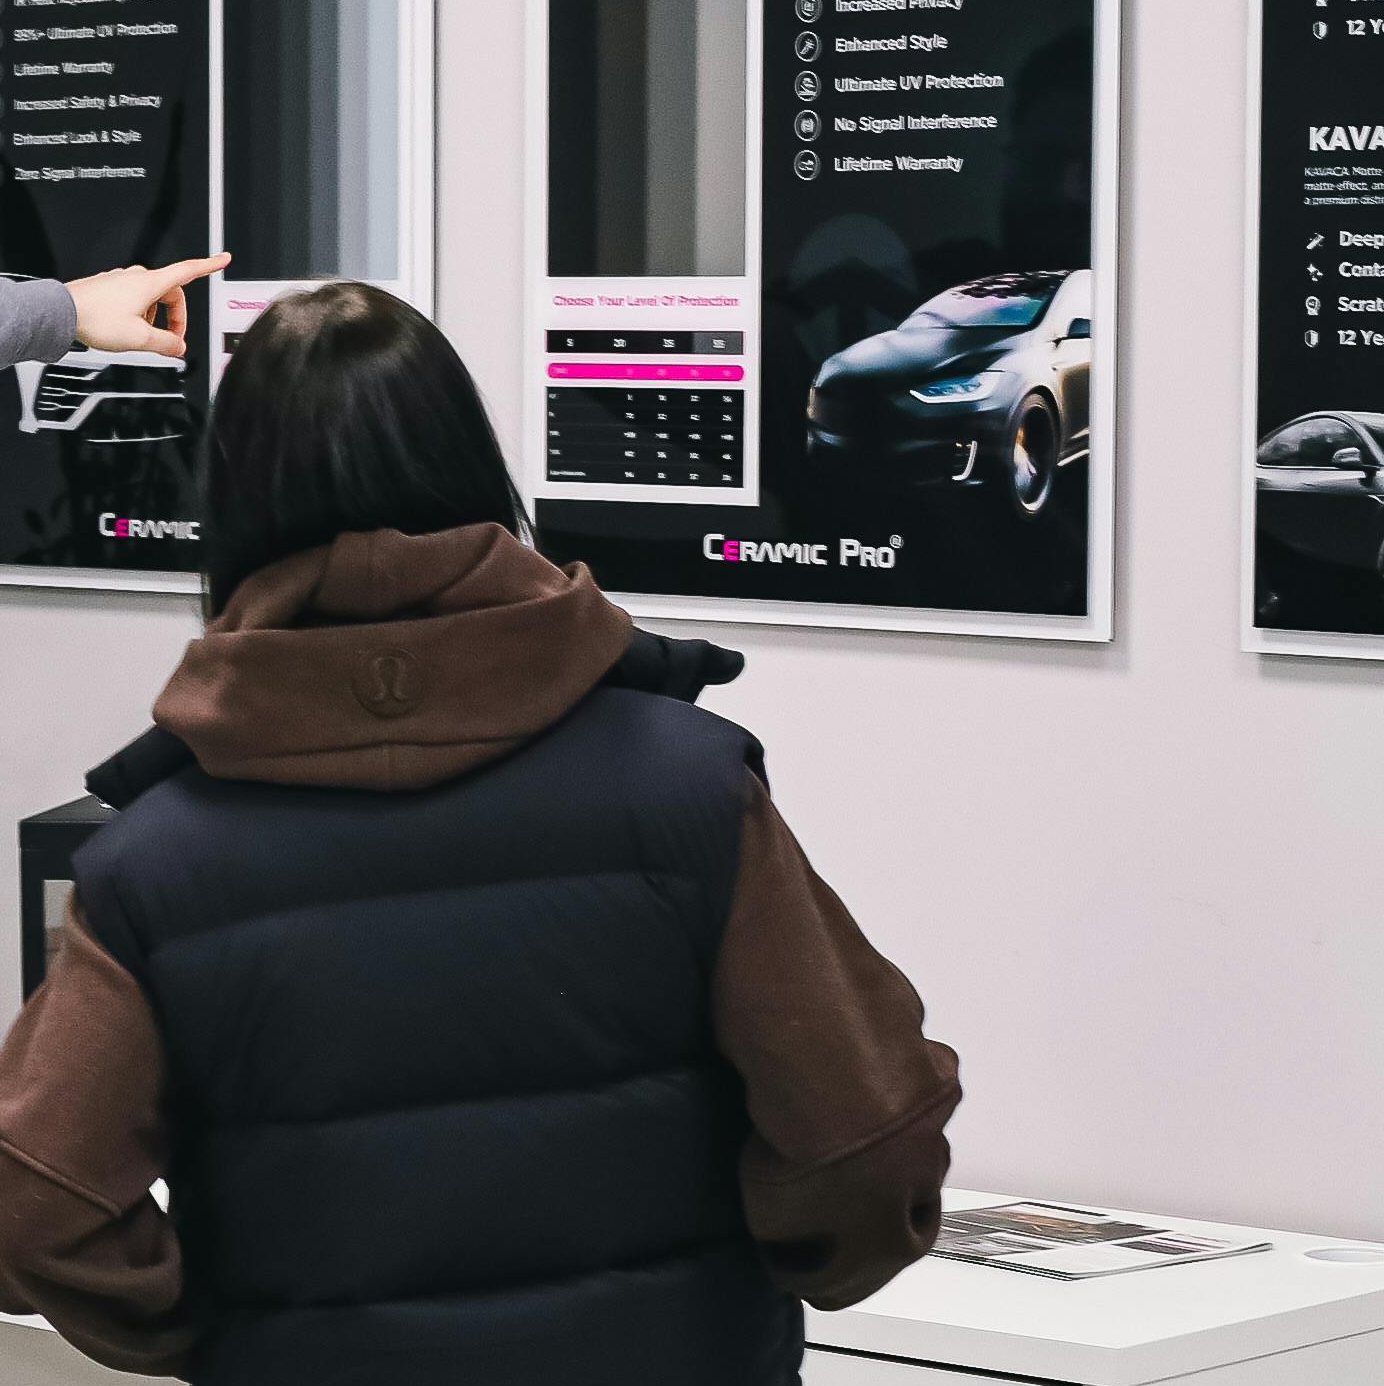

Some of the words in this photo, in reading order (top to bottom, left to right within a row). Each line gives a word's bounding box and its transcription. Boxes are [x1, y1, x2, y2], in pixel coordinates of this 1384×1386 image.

[1345, 19, 1366, 36] 12
[835, 34, 908, 53] Enhanced
[909, 33, 949, 52] Style
[834, 76, 898, 93] Ultimate
[899, 75, 924, 91] UV
[925, 72, 1005, 90] Protection
[834, 117, 858, 132] No
[858, 115, 906, 134] Signal
[907, 113, 998, 130] Interference
[833, 156, 894, 172] Lifetime
[894, 155, 964, 173] Warranty
[1337, 329, 1357, 346] 12
